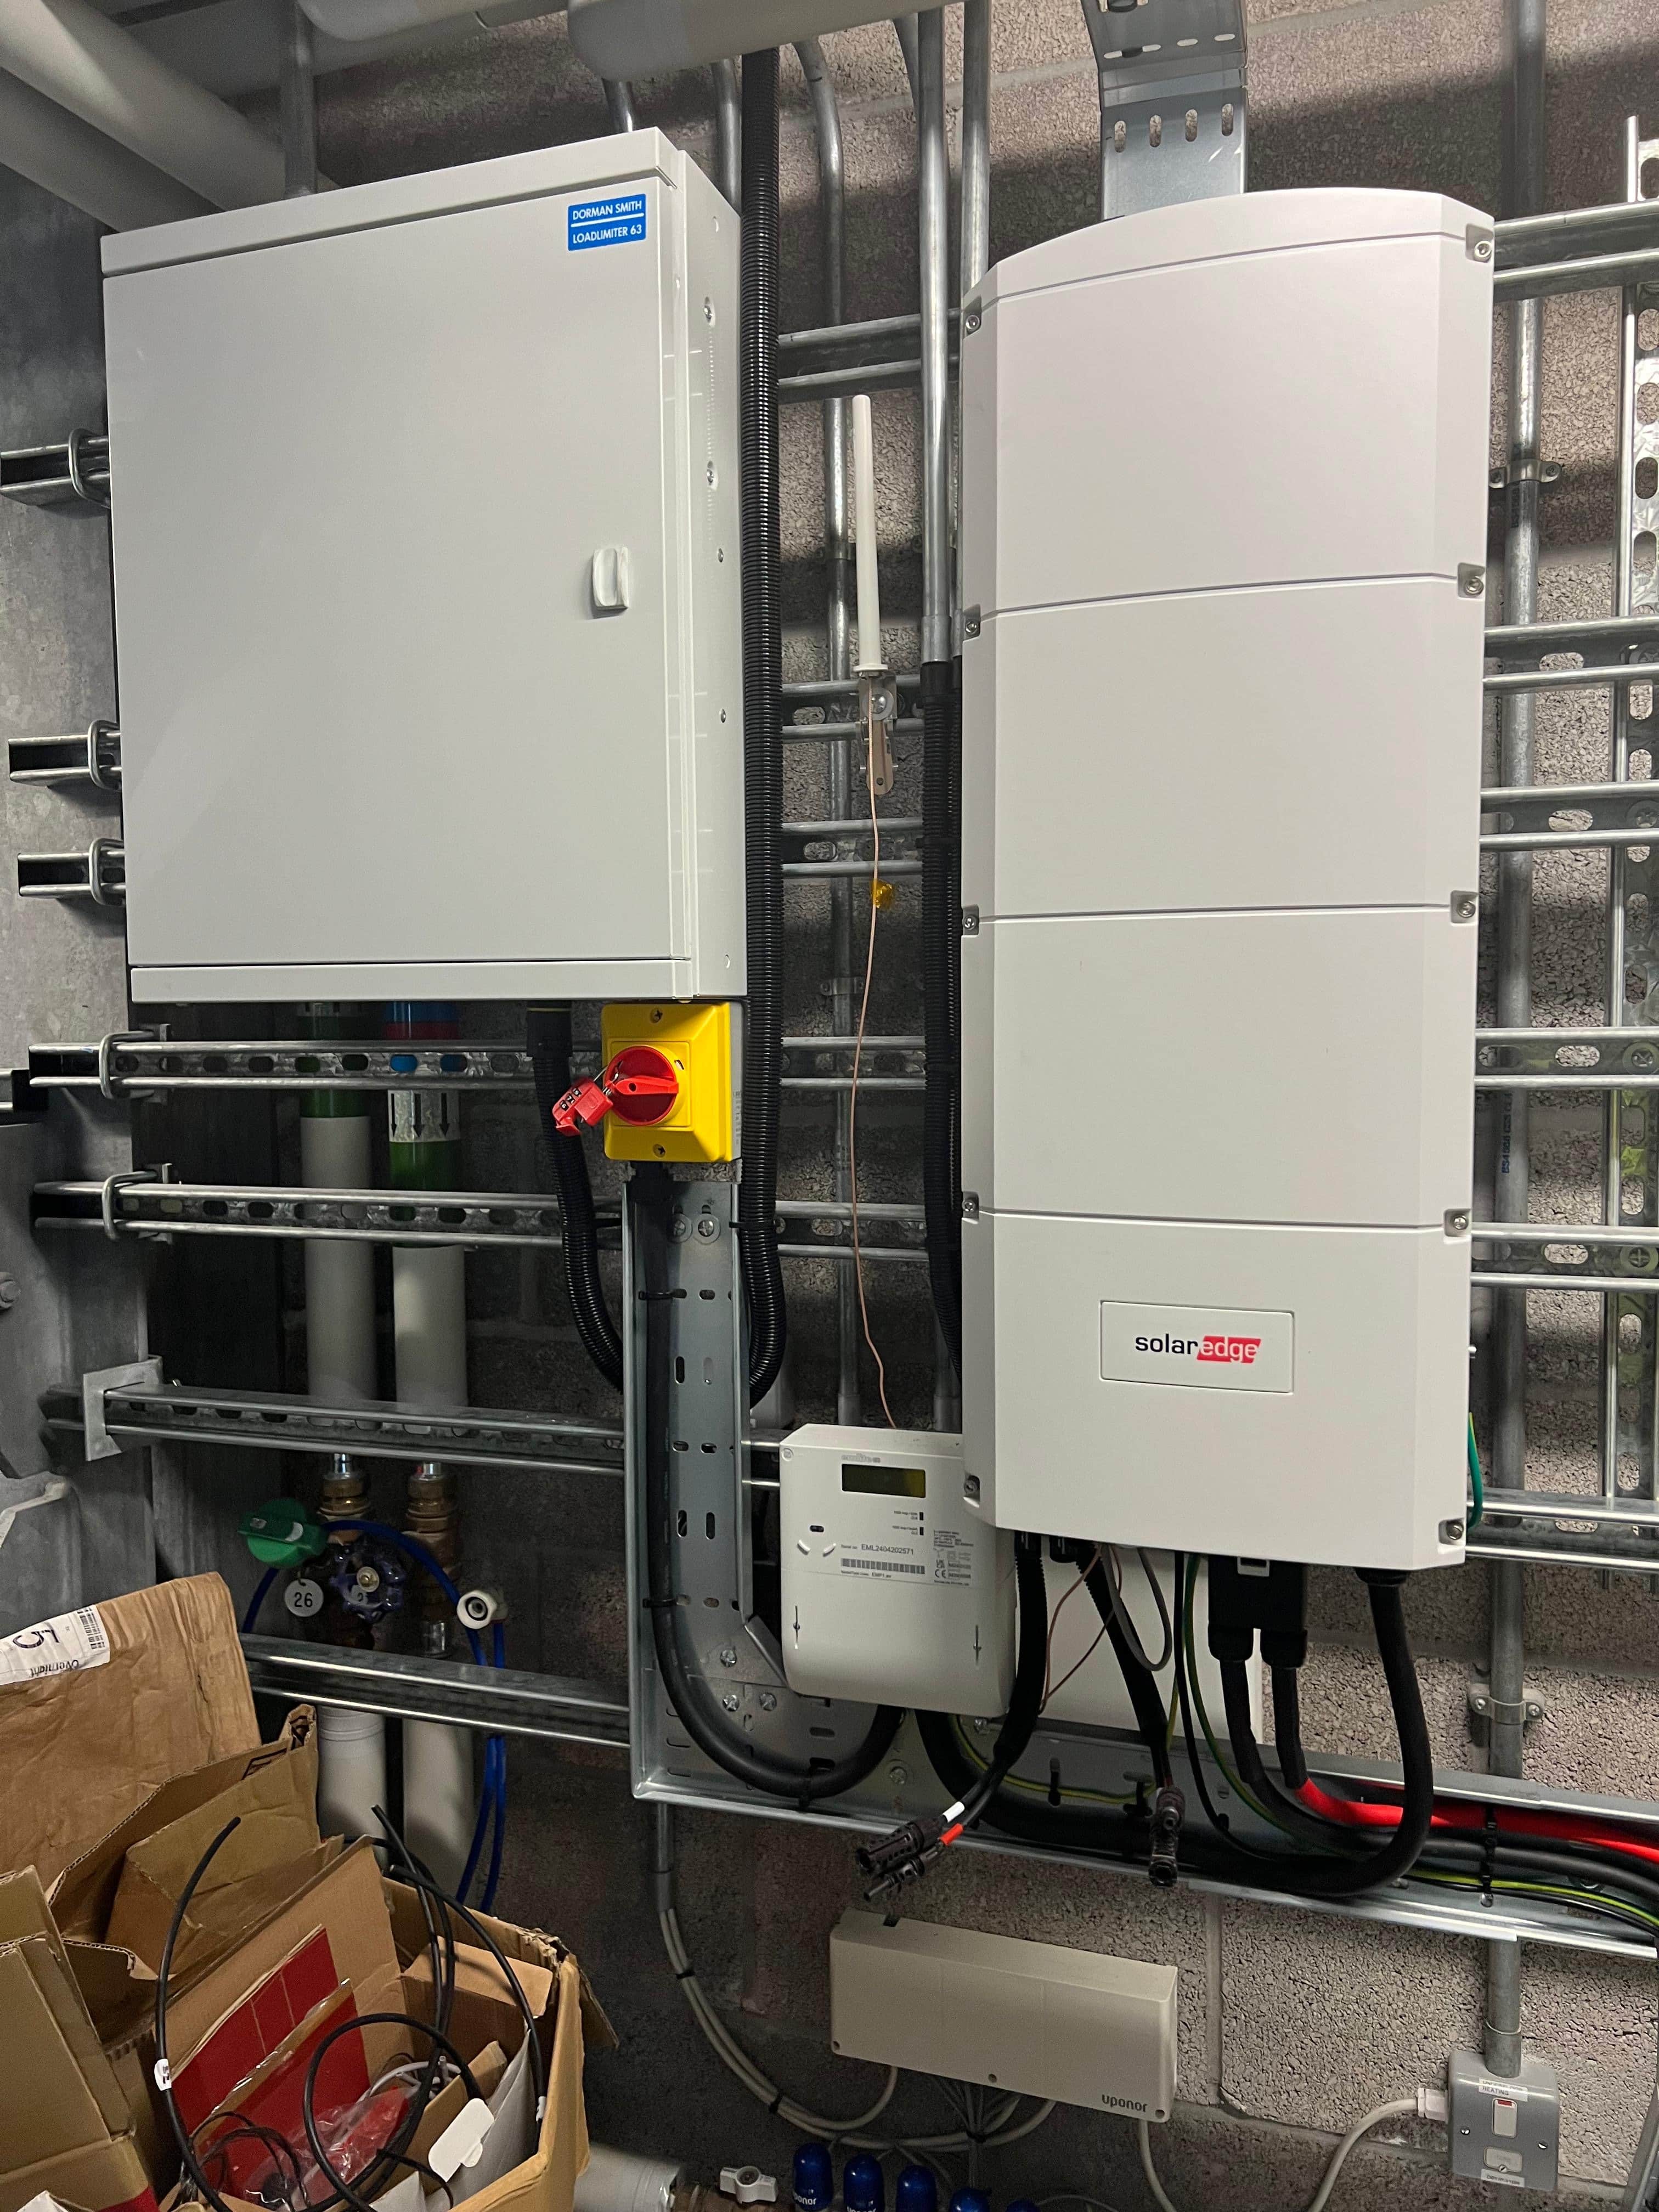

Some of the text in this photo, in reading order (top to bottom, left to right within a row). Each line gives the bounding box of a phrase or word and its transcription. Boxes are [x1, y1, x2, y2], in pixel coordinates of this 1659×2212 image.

[573, 200, 642, 220] DORMAN SMITH
[573, 224, 642, 244] LOADLIMITER 63
[1135, 1333, 1259, 1363] solaredge
[294, 1592, 313, 1607] 26
[1482, 2086, 1509, 2096] HEATING
[1102, 2094, 1148, 2112] uponor
